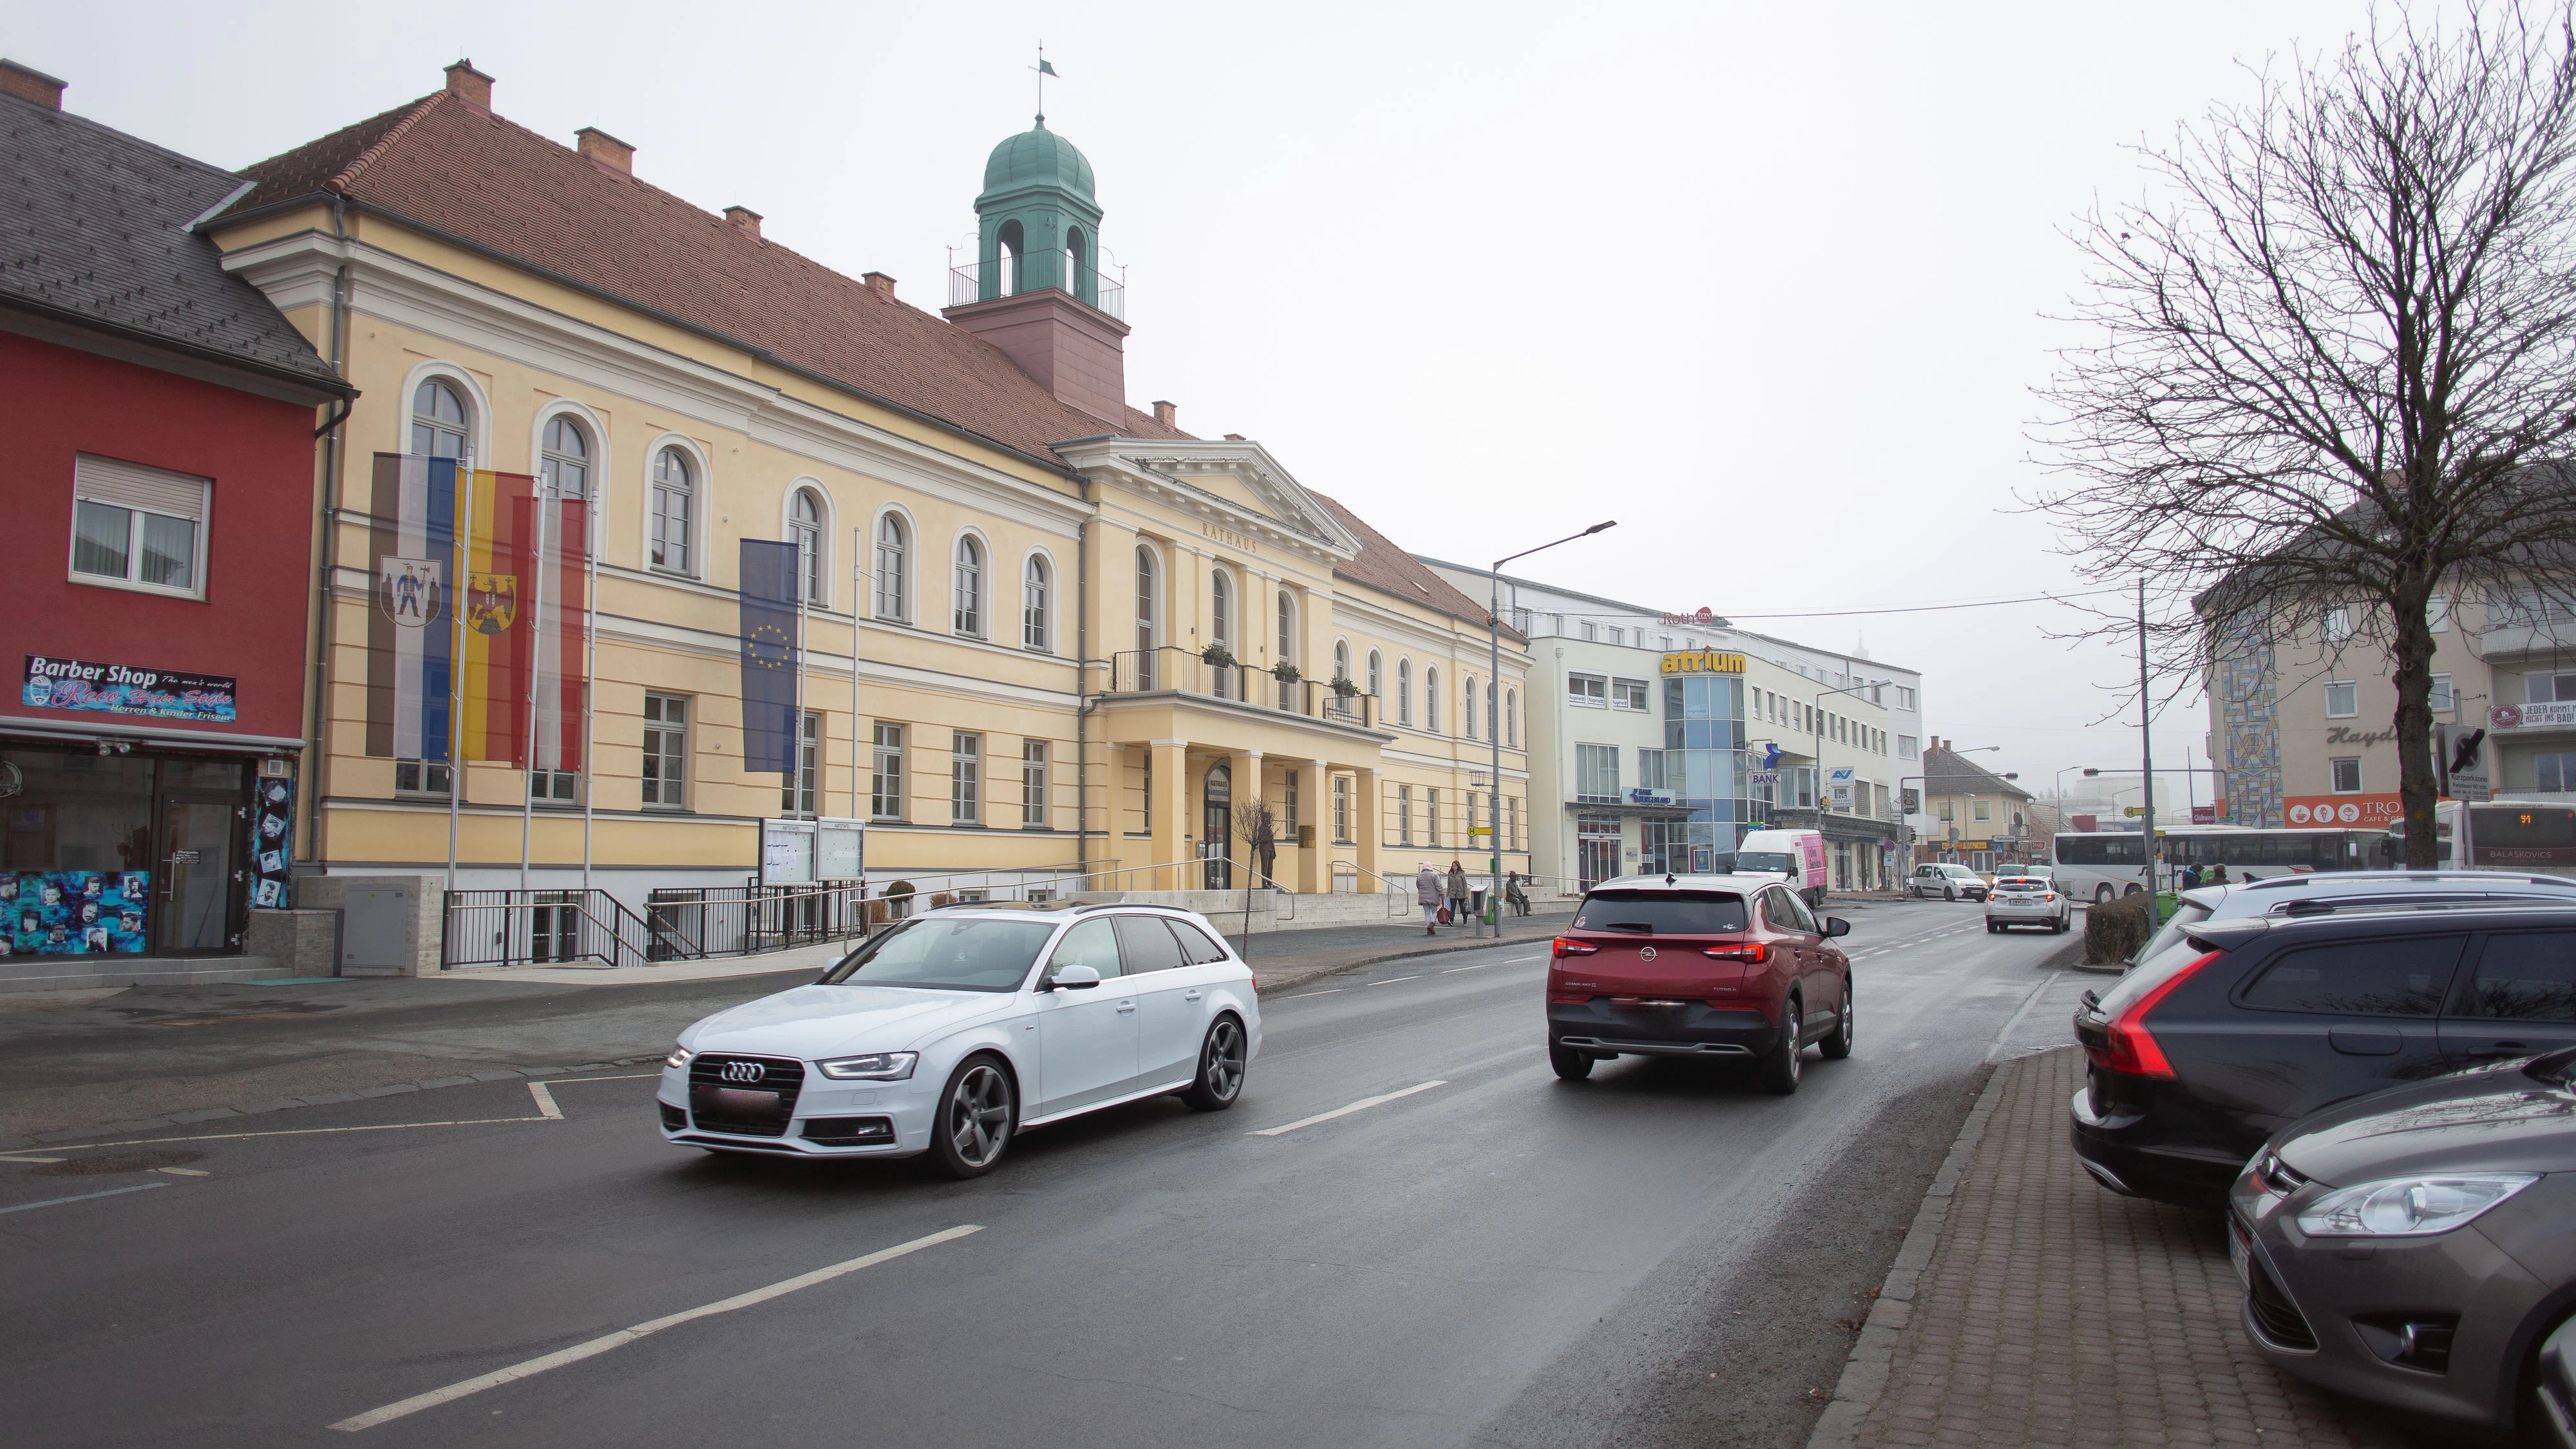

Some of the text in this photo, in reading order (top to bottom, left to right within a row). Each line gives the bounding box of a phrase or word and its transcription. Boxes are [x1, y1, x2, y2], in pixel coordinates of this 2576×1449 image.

[1202, 522, 1256, 553] RATHAUS
[1663, 612, 1695, 625] Roth
[1661, 646, 1747, 673] atrium
[30, 658, 157, 689] Barber Shop
[52, 679, 232, 707] Reco Hair Style
[111, 704, 147, 714] Herren
[160, 708, 193, 717] Kinder
[198, 712, 231, 721] Friseur
[2525, 705, 2547, 715] JEDER
[2550, 705, 2570, 713] KOMMT
[2525, 714, 2543, 723] NICHT
[2557, 713, 2574, 723] BAD!
[1754, 775, 1779, 783] BANK
[2451, 774, 2488, 782] Kurzparkzone
[2363, 802, 2404, 815] TRO
